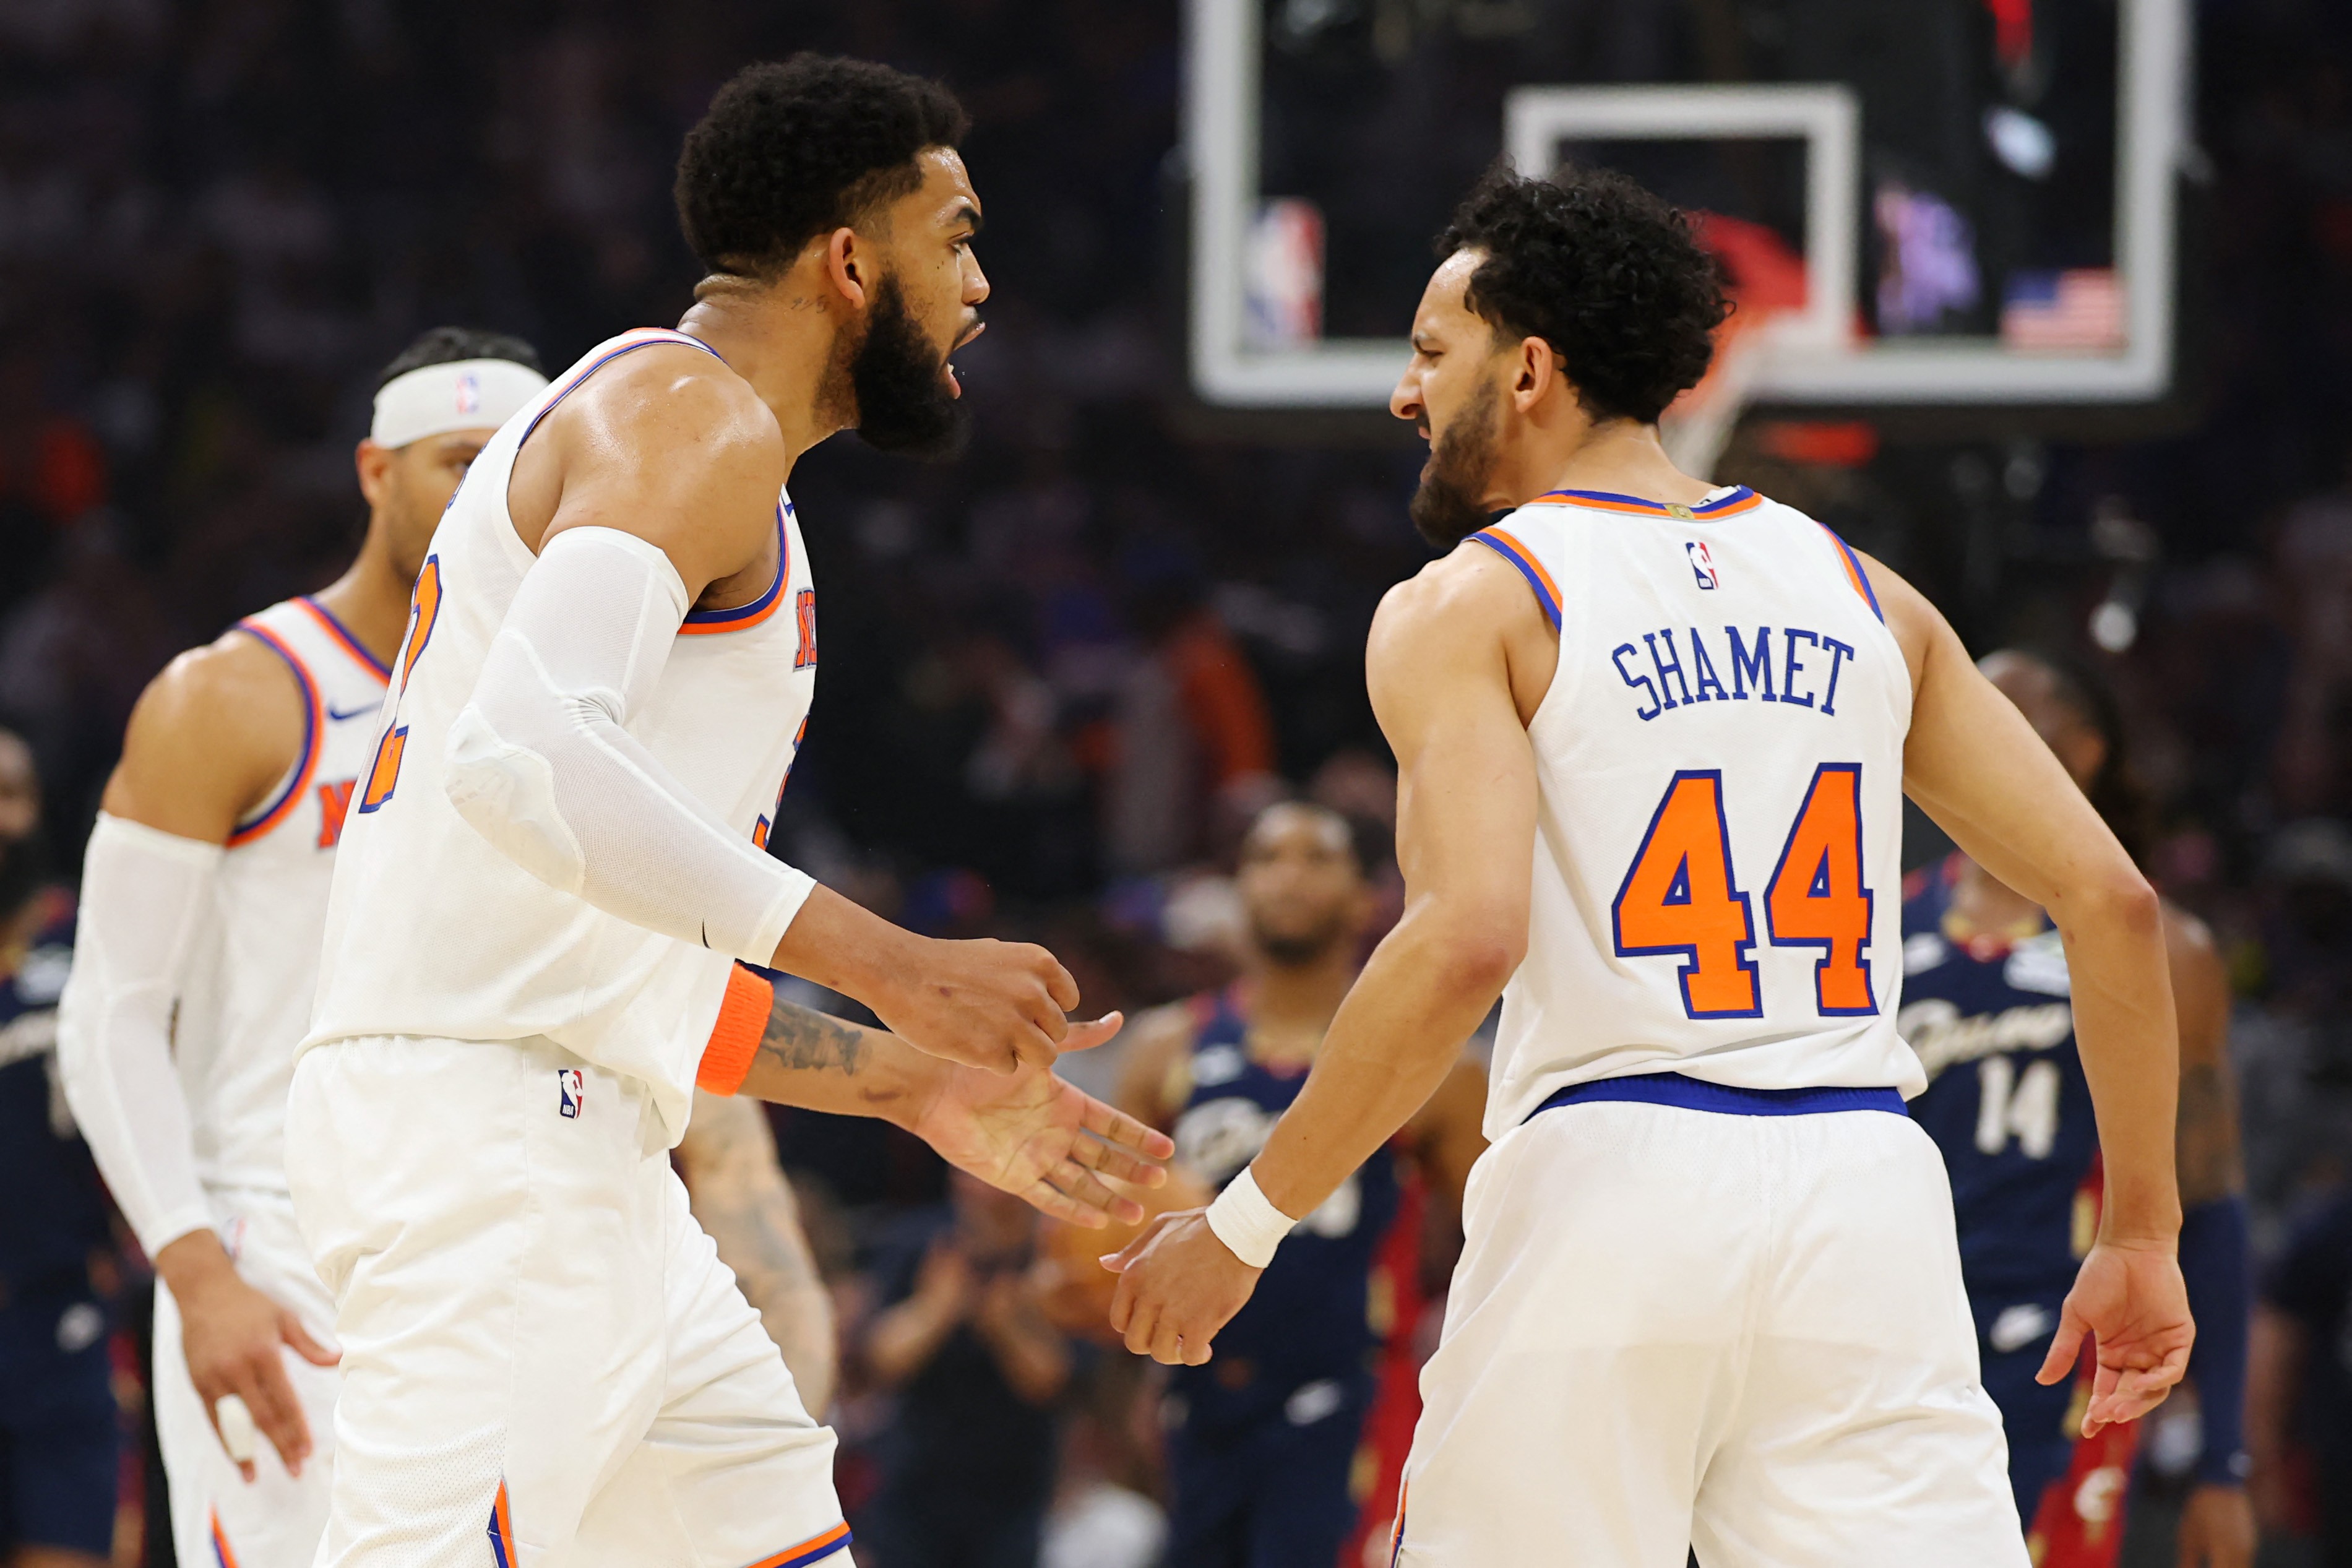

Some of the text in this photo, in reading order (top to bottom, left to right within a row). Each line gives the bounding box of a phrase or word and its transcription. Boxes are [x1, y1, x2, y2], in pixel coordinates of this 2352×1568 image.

[358, 553, 442, 814] 2
[1611, 626, 1855, 722] SHAMET
[1611, 762, 1881, 1020] 44
[562, 1104, 574, 1116] NBA
[1974, 1054, 2062, 1160] 14
